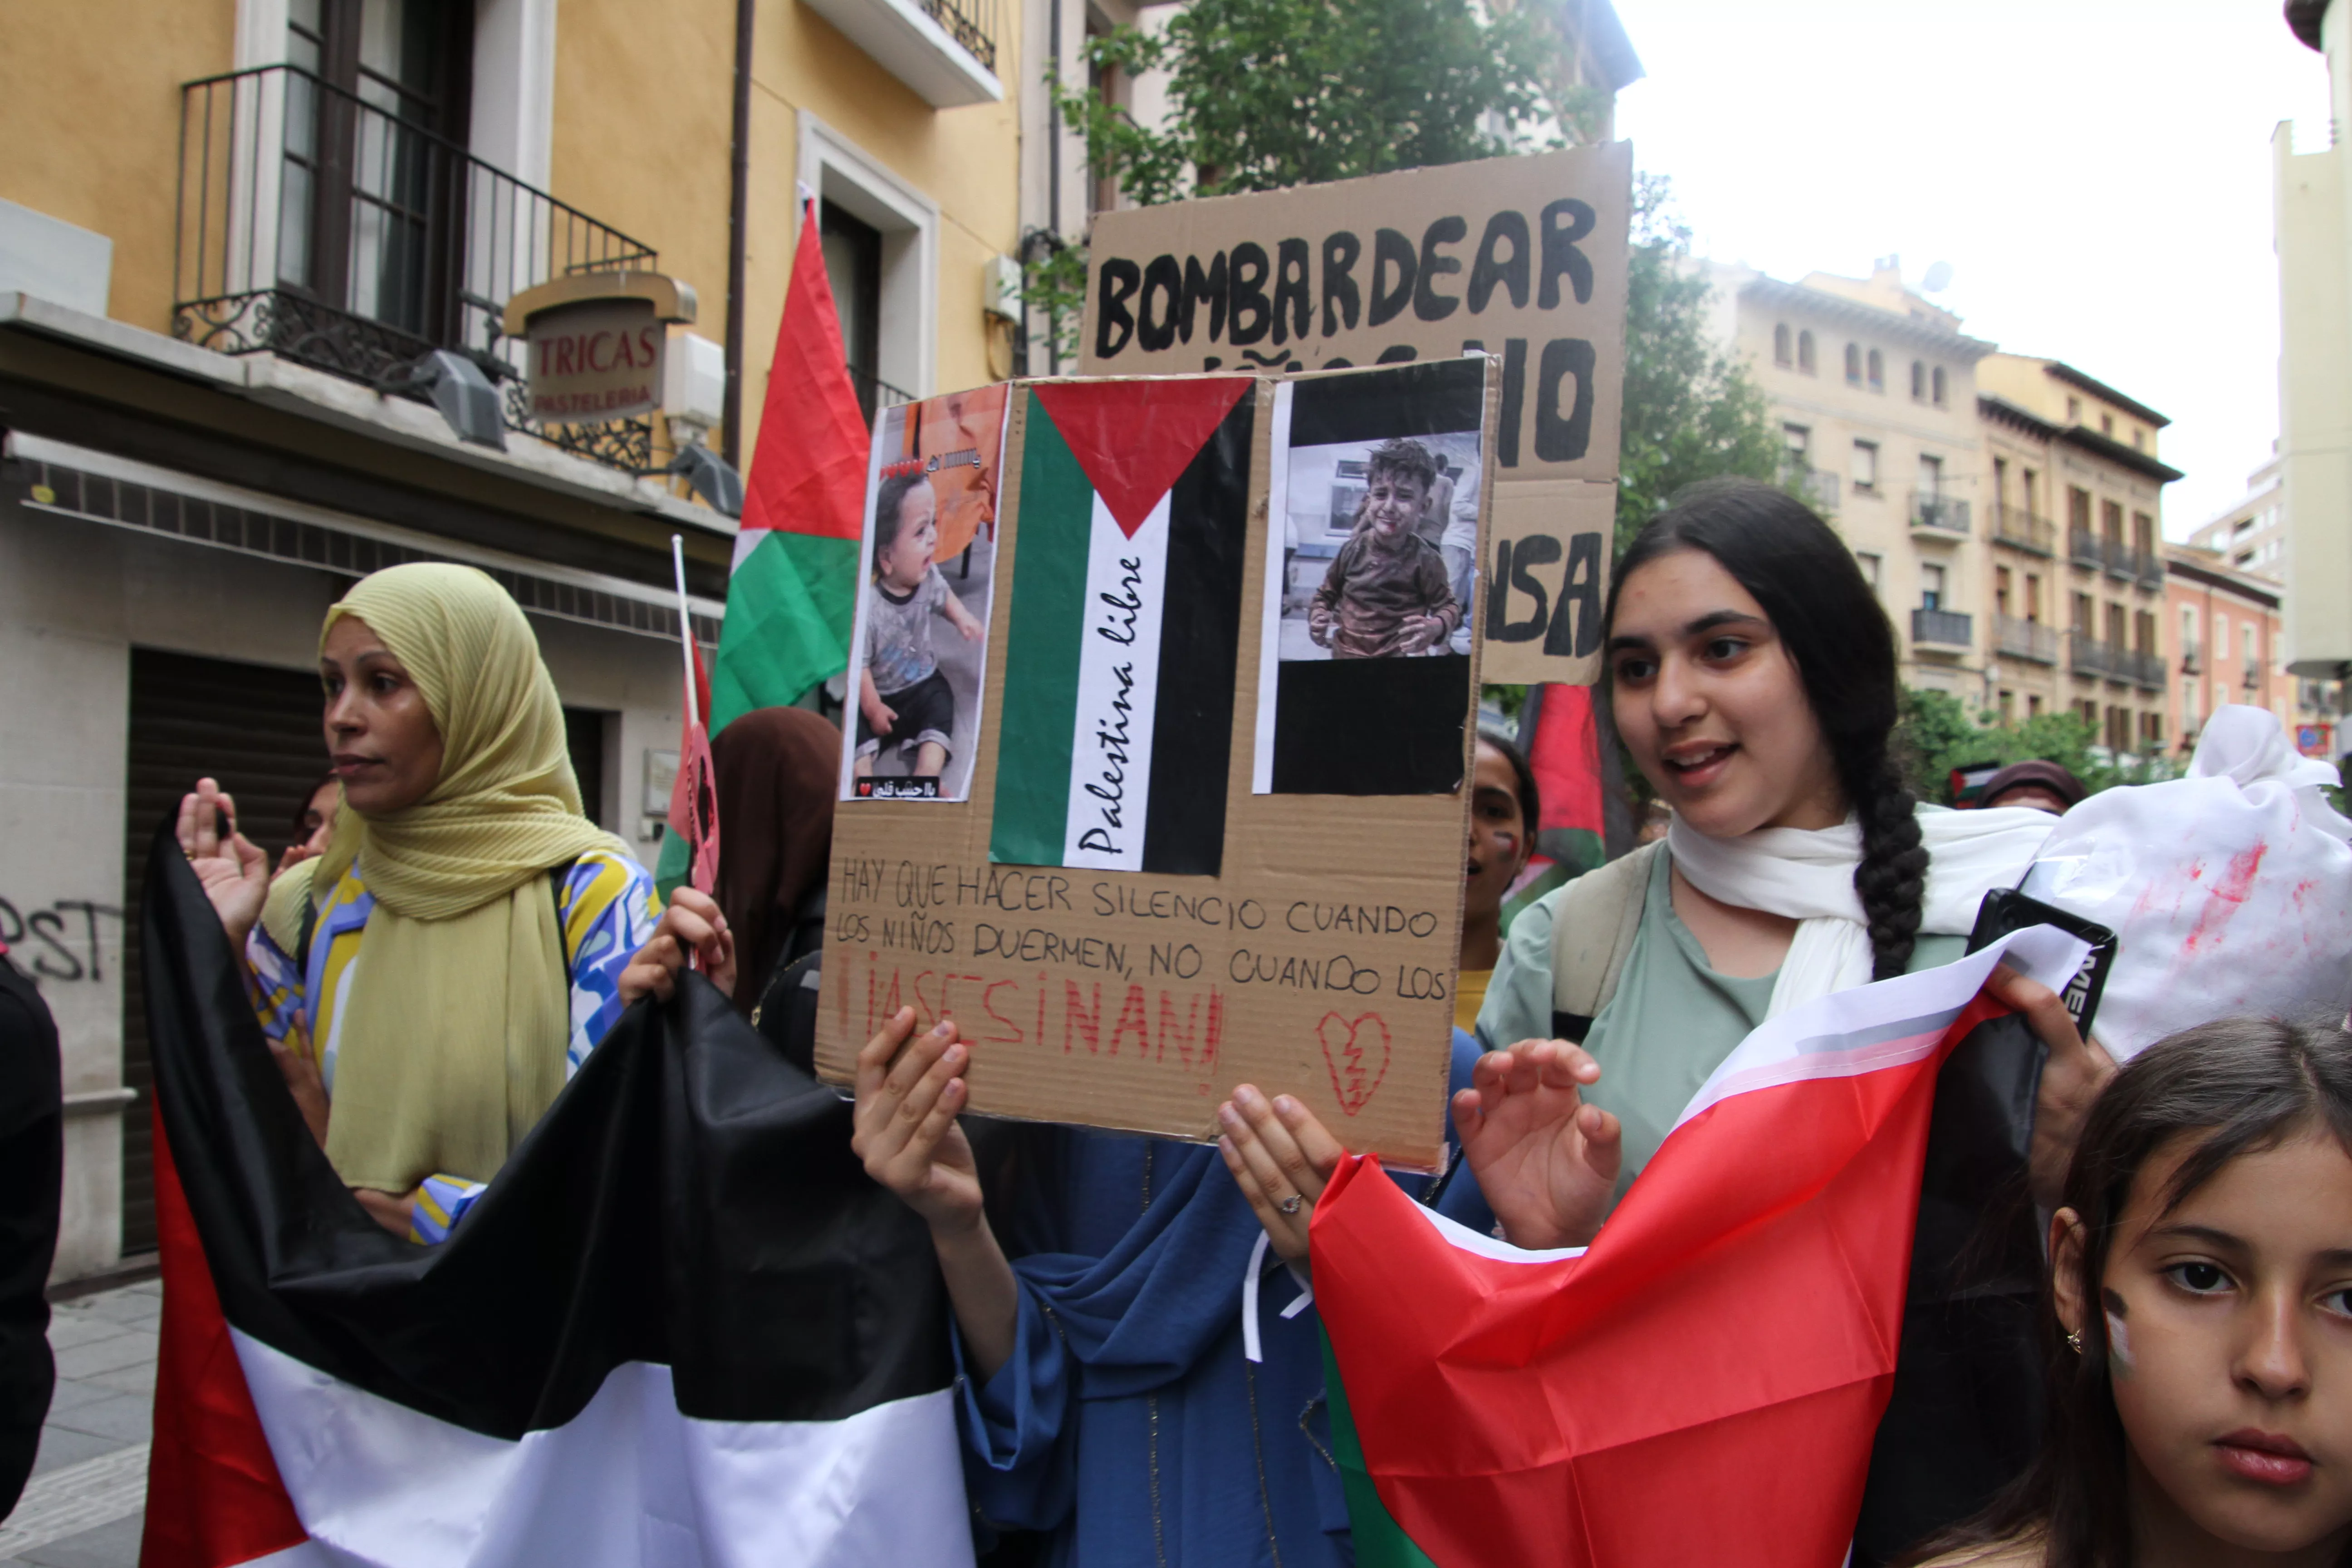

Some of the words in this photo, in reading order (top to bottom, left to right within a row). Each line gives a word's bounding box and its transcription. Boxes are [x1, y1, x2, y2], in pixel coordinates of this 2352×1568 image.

[1095, 198, 1596, 359] BOMBARDEAR
[536, 326, 658, 377] TRICAS
[1097, 556, 1142, 647] libre
[1078, 662, 1135, 855] Palestina
[841, 857, 886, 904] HAY
[896, 860, 947, 909] QUE
[956, 867, 1073, 911] HACER
[1093, 882, 1266, 930] SILENCIO
[1286, 902, 1437, 937] CUANDO
[836, 913, 870, 943] LOS
[882, 911, 956, 955] NIÑOS
[973, 924, 1133, 980] DUERMEN,
[1150, 942, 1202, 979] NO
[1229, 949, 1380, 994] CUANDO
[1396, 965, 1446, 1000] LOS
